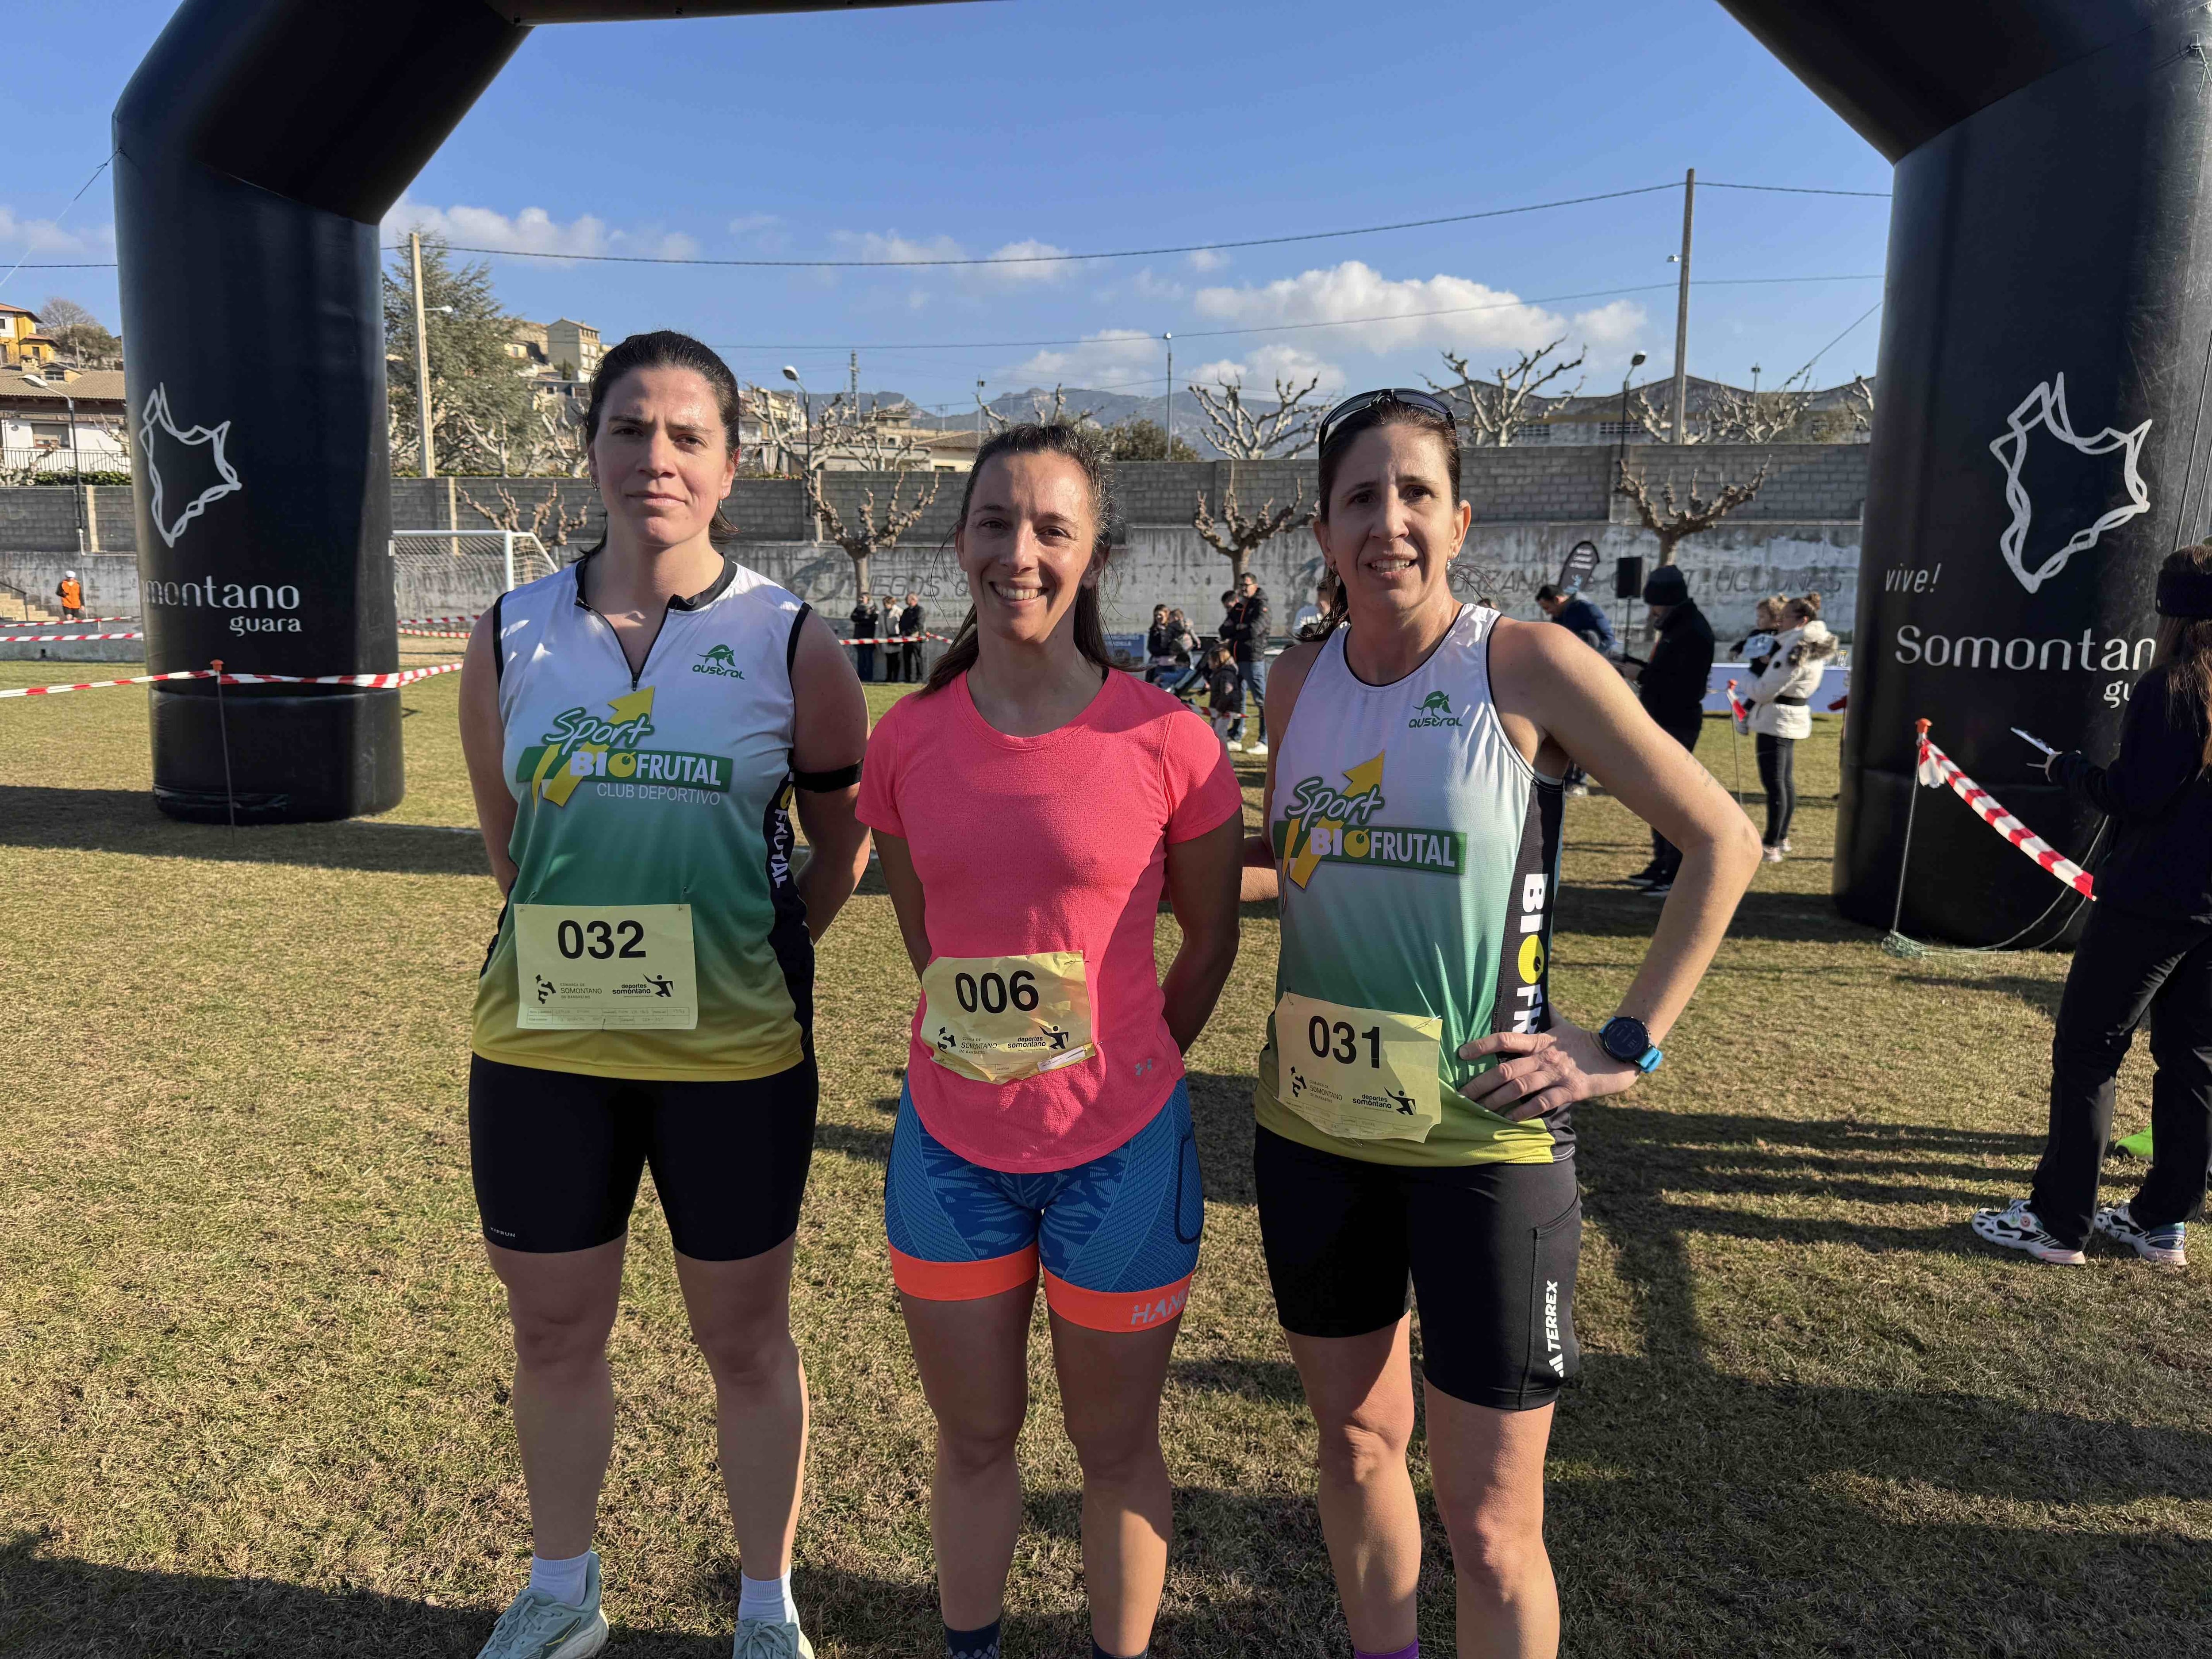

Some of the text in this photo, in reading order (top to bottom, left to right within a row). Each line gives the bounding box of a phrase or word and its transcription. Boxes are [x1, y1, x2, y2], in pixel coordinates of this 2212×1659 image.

[142, 576, 300, 610] montano
[1885, 563, 1941, 593] vive!
[229, 615, 303, 637] guara
[692, 664, 745, 680] austral
[544, 708, 653, 755] Sport
[1408, 717, 1463, 728] austral
[570, 751, 722, 786] BIOFRUTAL
[596, 782, 721, 805] CLUB DEPORTIVO
[1286, 778, 1383, 831] Sport
[1310, 827, 1455, 867] BIOFRUTAL
[557, 920, 646, 959] 032
[955, 970, 1039, 1014] 006
[1309, 1016, 1380, 1069] 031
[1310, 1085, 1343, 1101] SOMONTANO
[1352, 1098, 1392, 1109] somontano
[1545, 1280, 1561, 1352] TERREX
